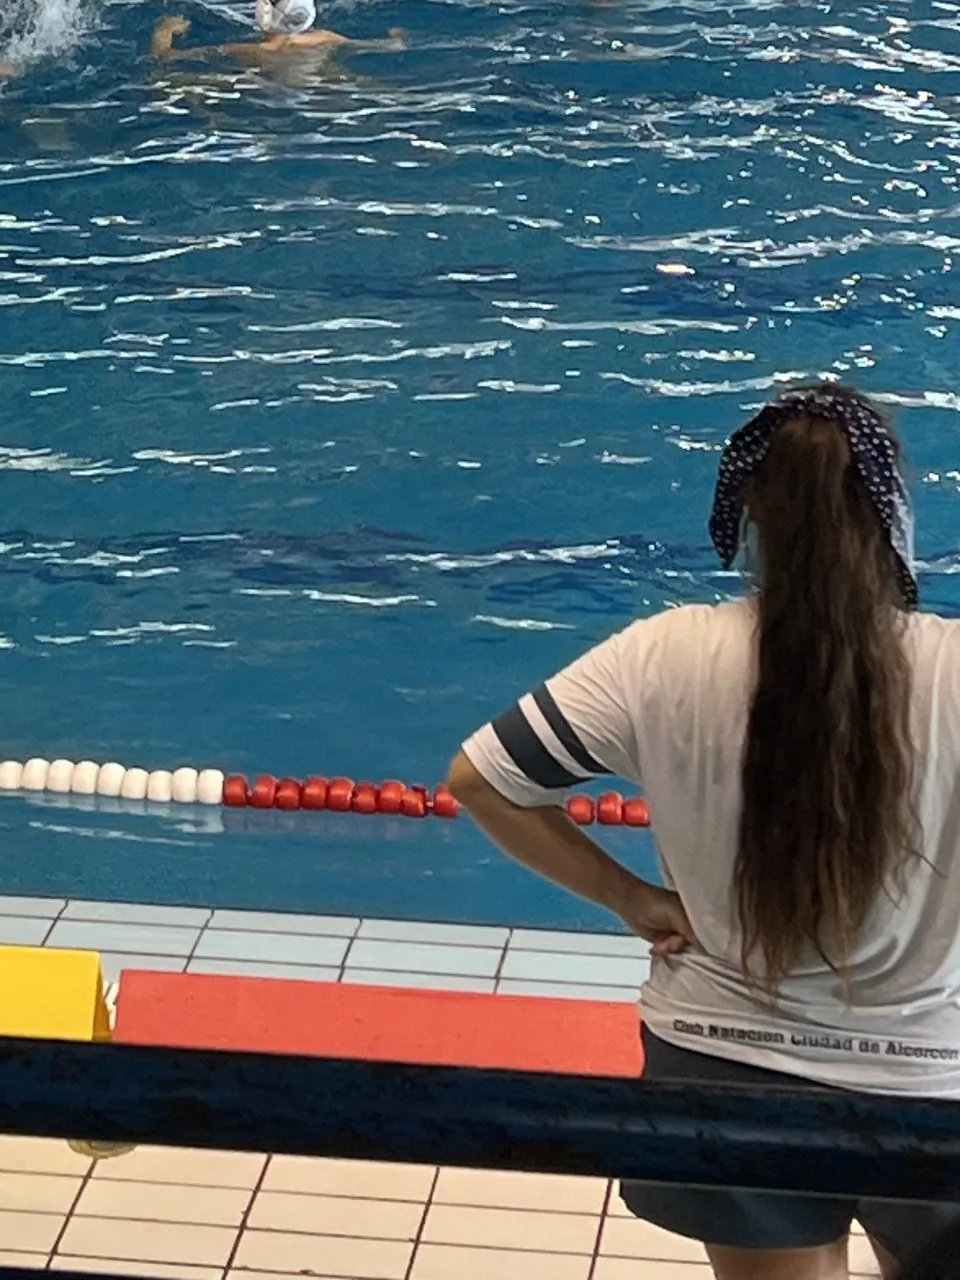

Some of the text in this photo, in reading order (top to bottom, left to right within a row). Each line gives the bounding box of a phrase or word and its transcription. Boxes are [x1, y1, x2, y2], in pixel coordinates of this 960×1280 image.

[673, 1019, 704, 1036] Club
[790, 1033, 852, 1051] Ciudad
[858, 1038, 880, 1053] de
